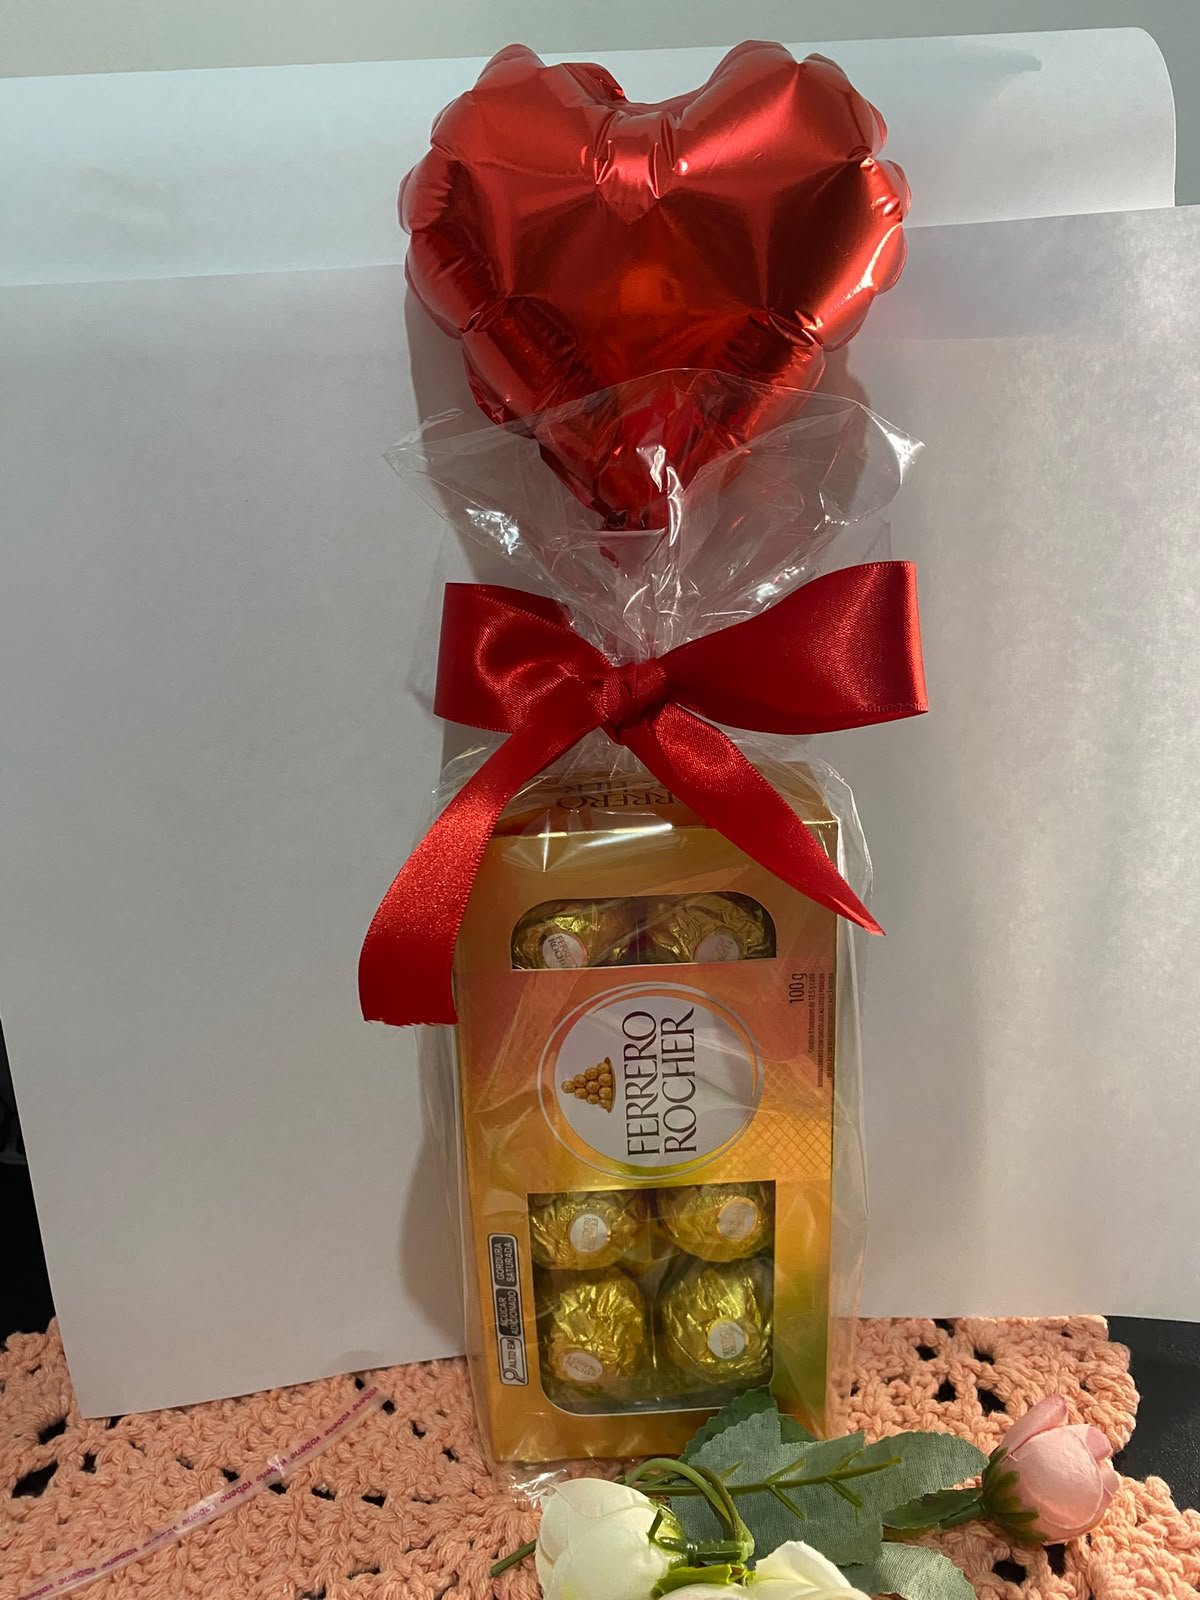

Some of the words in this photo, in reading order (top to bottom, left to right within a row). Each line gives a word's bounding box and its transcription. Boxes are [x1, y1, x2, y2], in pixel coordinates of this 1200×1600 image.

[556, 791, 675, 810] RRERO
[789, 983, 804, 1003] 100
[621, 1011, 660, 1157] FERRERO
[660, 1007, 696, 1154] ROCHER
[493, 1243, 504, 1281] GORDURA
[503, 1242, 515, 1282] SATURADA
[507, 1291, 519, 1335] ADICIONADO
[506, 1339, 516, 1350] EM
[507, 1351, 518, 1369] ALTO
[324, 1411, 351, 1436] vabene
[290, 1436, 321, 1460] vabene
[220, 1481, 253, 1504] vabene
[58, 1566, 97, 1585] vabene
